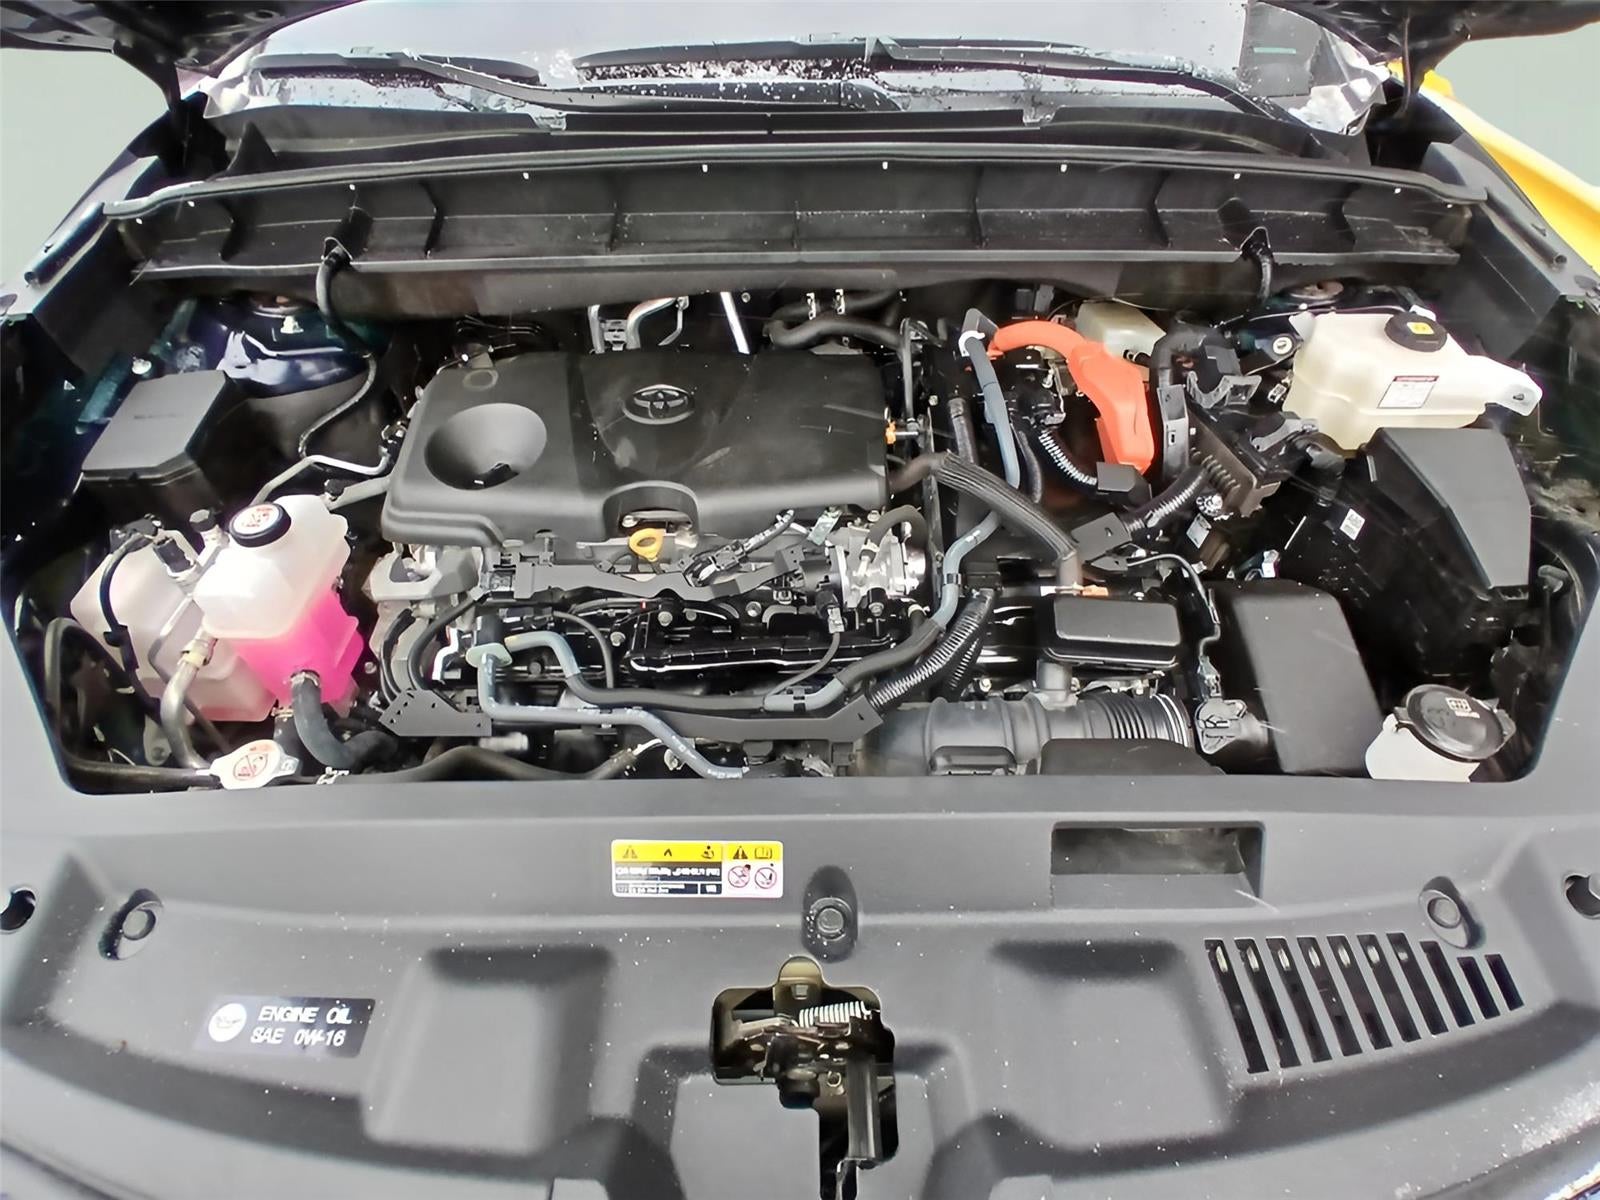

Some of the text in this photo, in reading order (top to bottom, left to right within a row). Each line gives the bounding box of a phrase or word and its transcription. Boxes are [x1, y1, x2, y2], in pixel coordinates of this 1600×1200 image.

[258, 1006, 353, 1024] ENGINE OIL
[250, 1026, 347, 1047] SAE 0W-16
